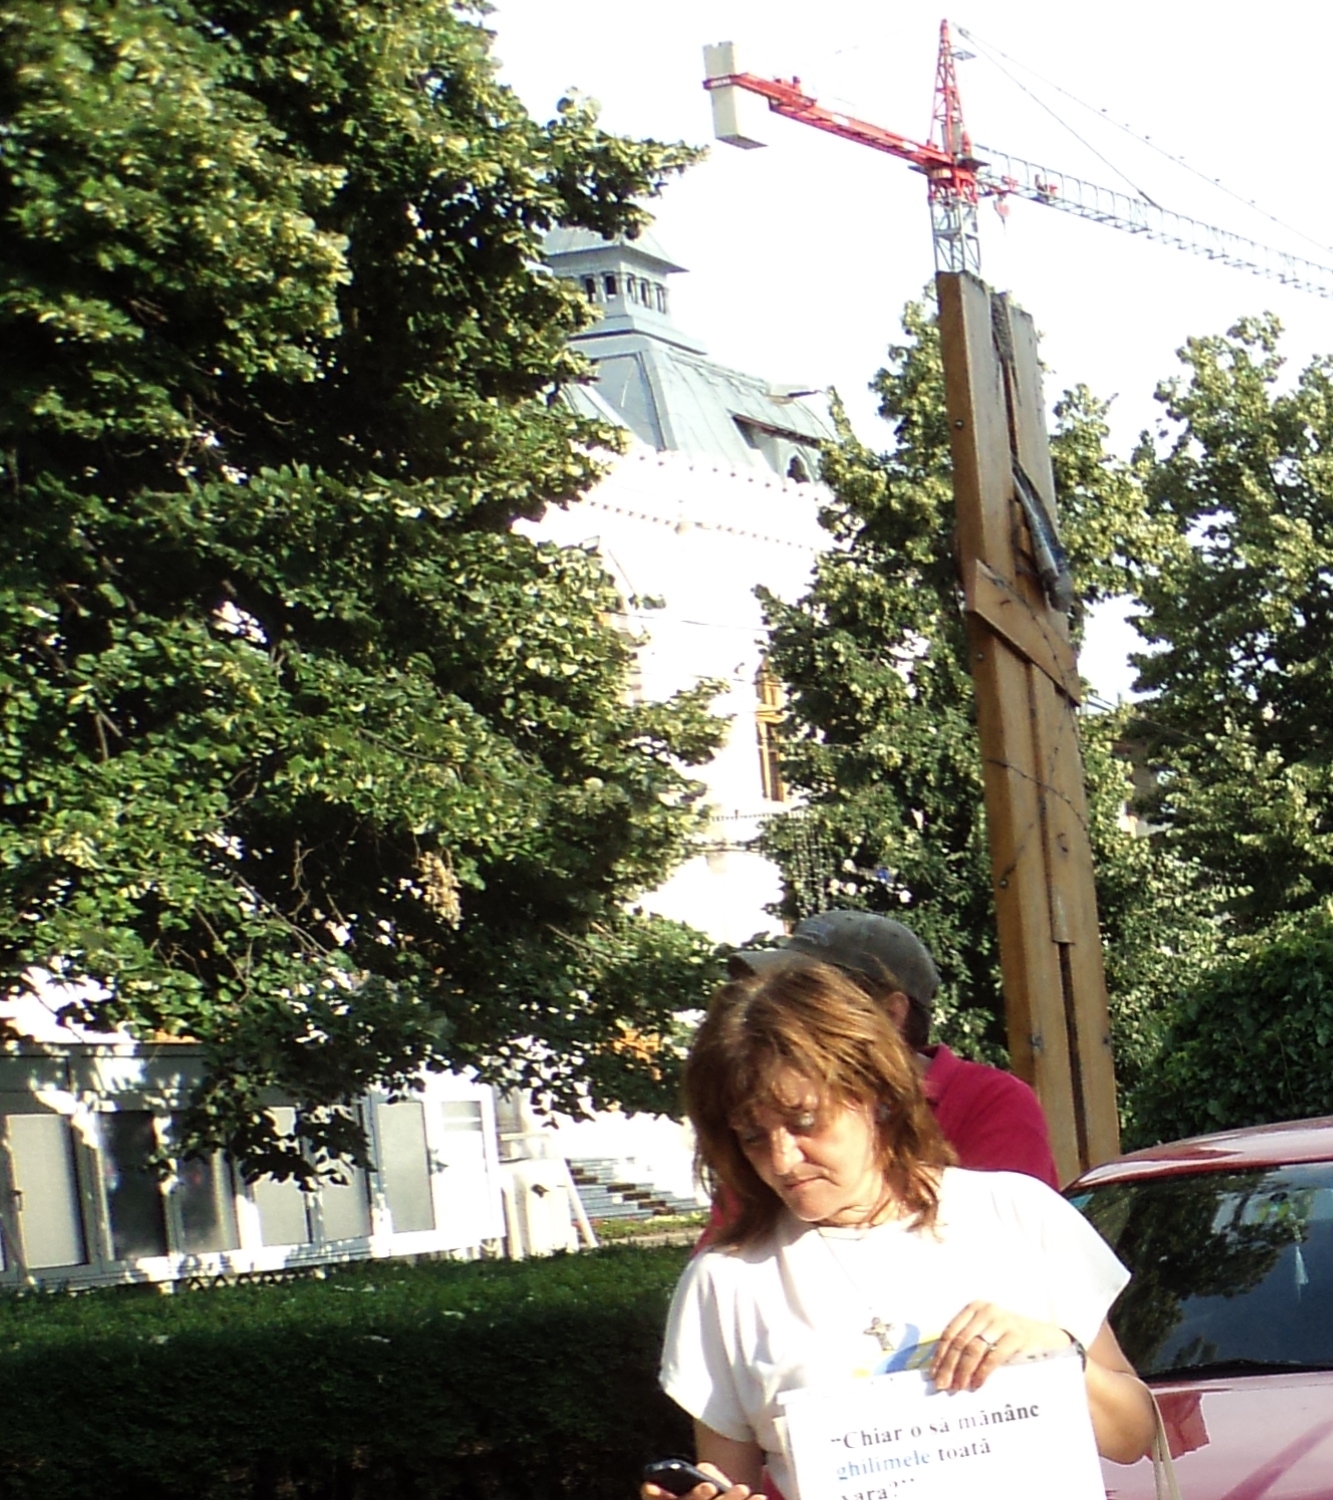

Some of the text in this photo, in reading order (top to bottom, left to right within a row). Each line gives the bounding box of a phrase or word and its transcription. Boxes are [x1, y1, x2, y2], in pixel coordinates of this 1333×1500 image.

[911, 1426, 922, 1437] o
[837, 1439, 991, 1480] ghilimele toată
